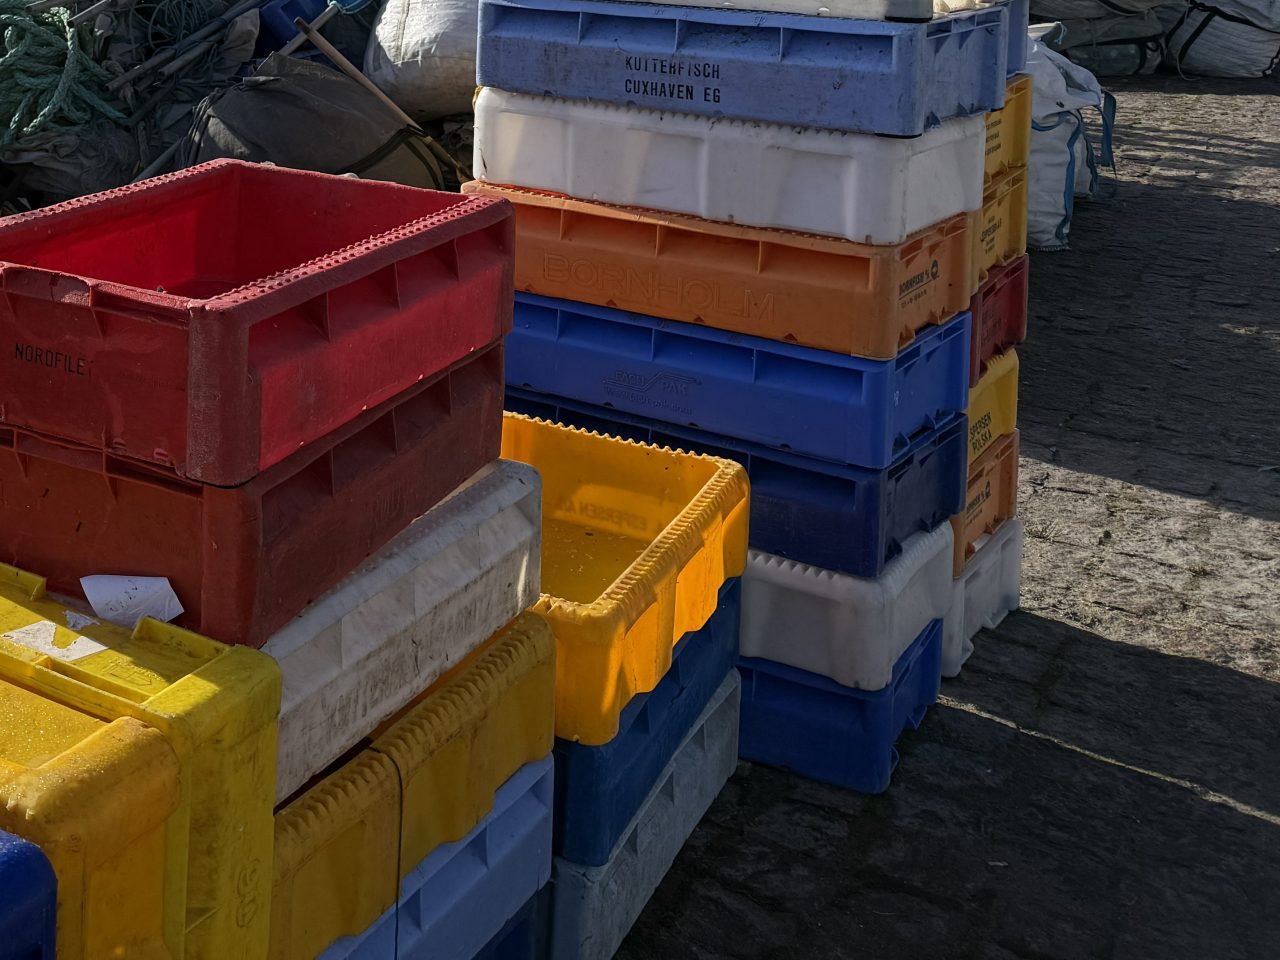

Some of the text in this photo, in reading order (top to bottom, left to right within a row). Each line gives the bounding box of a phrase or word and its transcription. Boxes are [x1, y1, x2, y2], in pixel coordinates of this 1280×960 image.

[625, 55, 720, 79] KUTTERFISCH
[624, 78, 721, 103] CUXHAVEN EG
[543, 252, 776, 322] BORNHOLM
[969, 412, 992, 442] SPERSEN
